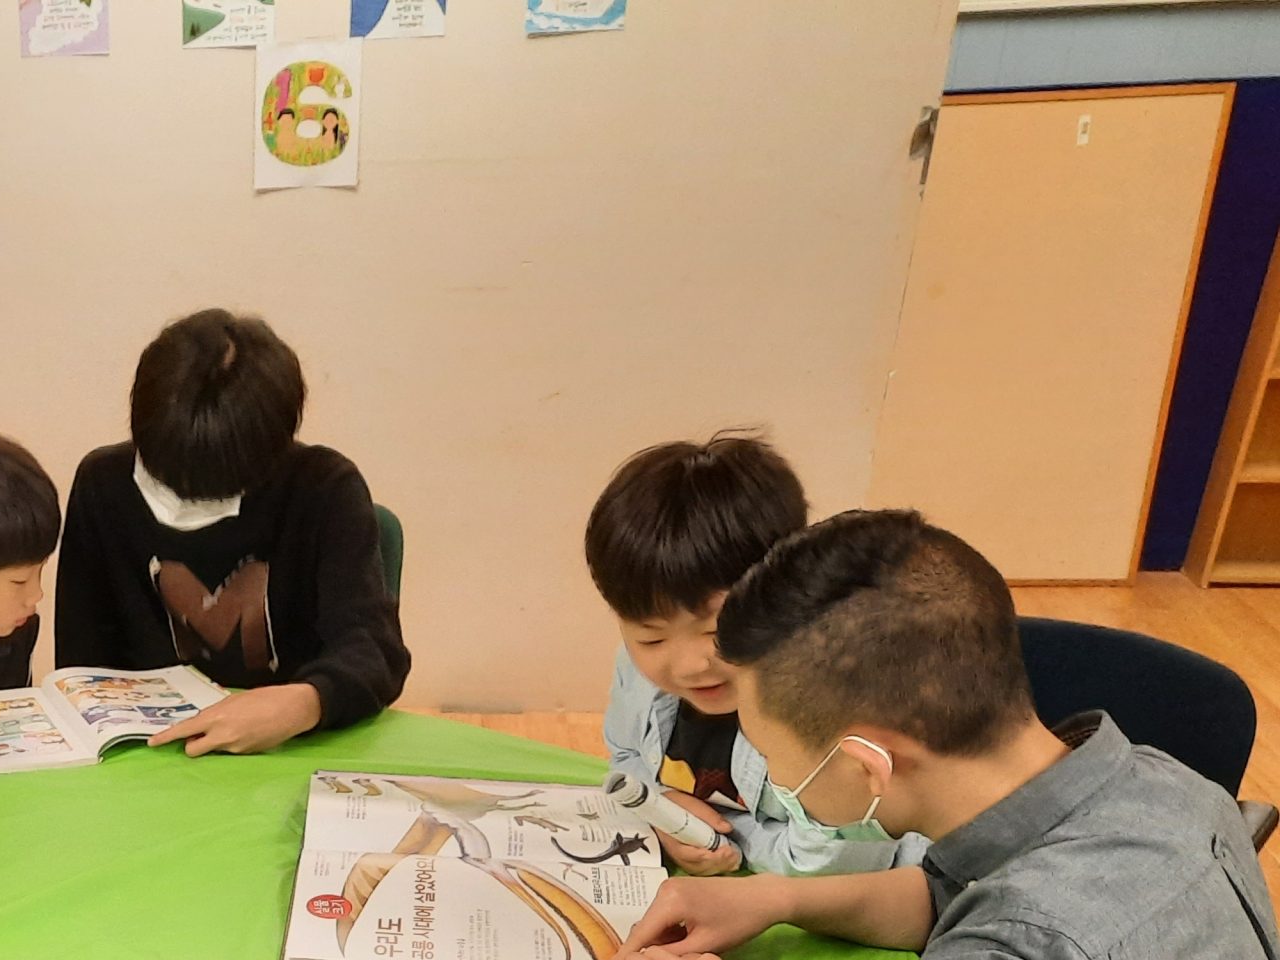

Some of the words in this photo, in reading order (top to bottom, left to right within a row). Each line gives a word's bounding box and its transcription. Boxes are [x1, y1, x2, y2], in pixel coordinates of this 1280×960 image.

[262, 61, 353, 167] 6
[313, 900, 330, 914] 실물
[330, 899, 345, 915] 크기
[412, 904, 436, 939] 시대에
[374, 917, 404, 957] 우리도
[412, 940, 435, 960] 공룡
